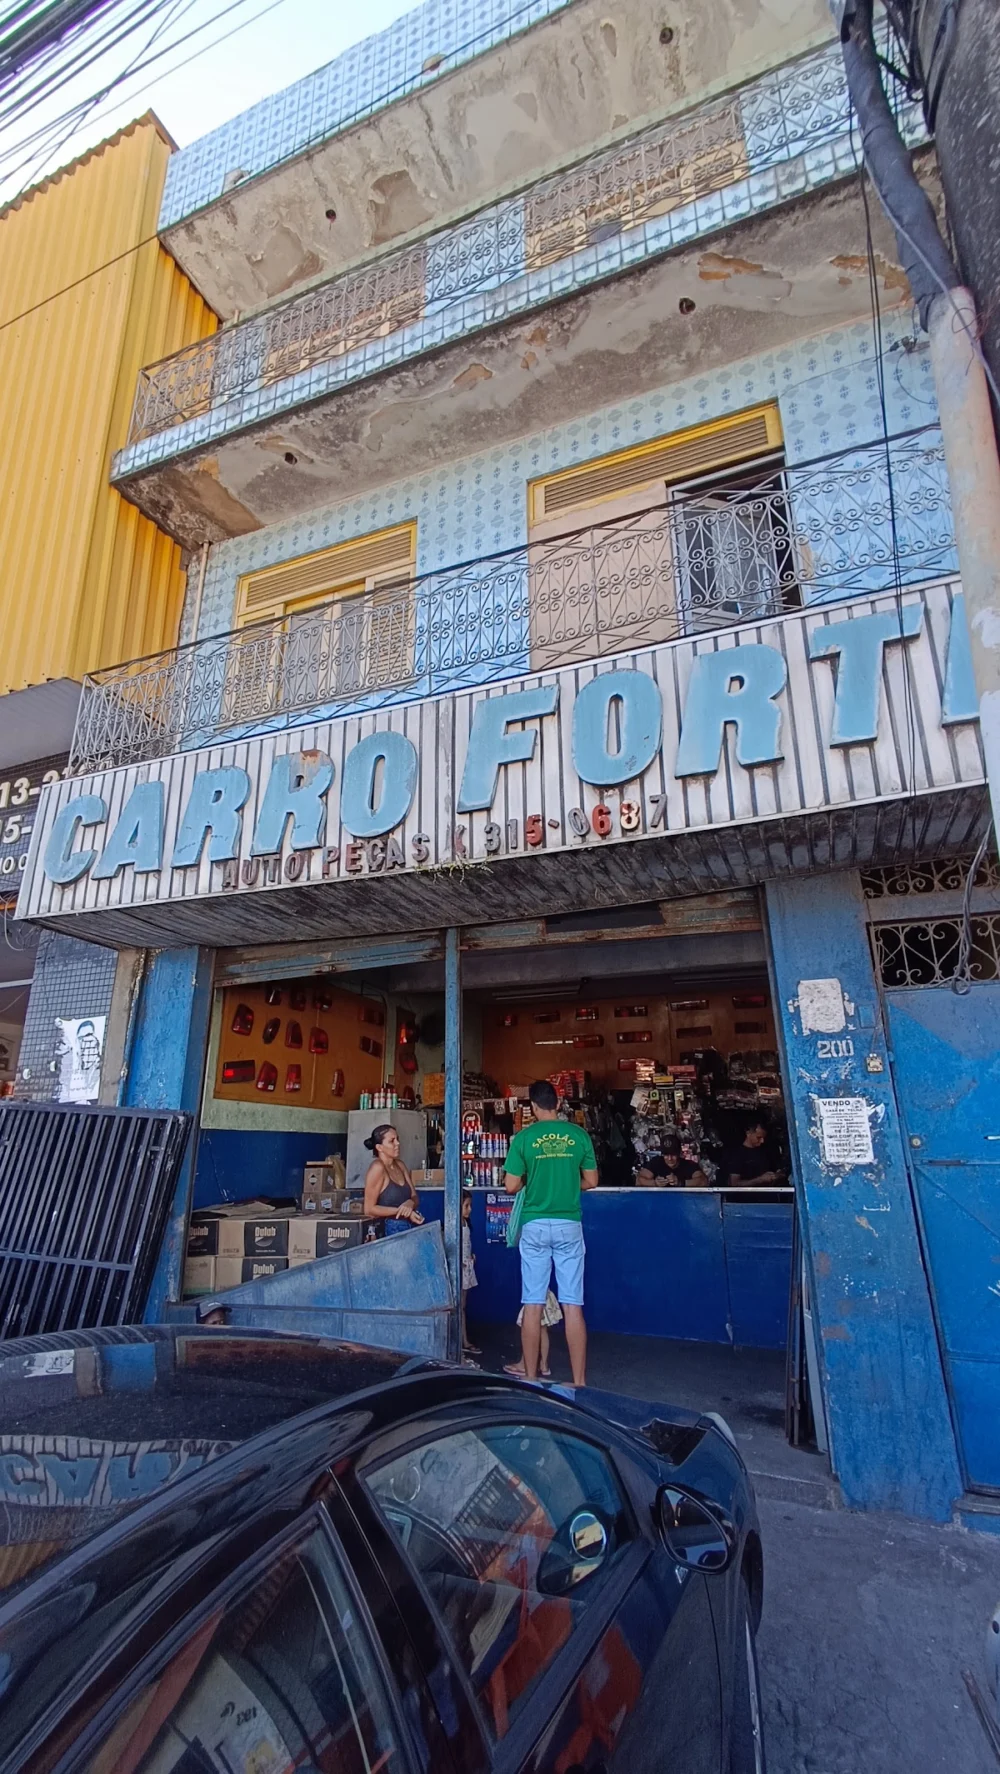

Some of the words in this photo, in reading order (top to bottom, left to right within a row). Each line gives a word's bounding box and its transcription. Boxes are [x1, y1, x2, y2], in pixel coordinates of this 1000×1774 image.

[43, 730, 419, 885] CARRO
[220, 850, 301, 889] AUTO
[322, 832, 431, 877] PEÇAS
[817, 1039, 855, 1059] 200
[531, 1133, 576, 1149] SACOLÃO
[254, 1226, 277, 1237] Dulub
[327, 1227, 350, 1238] Dulub
[252, 1263, 275, 1274] Dulub
